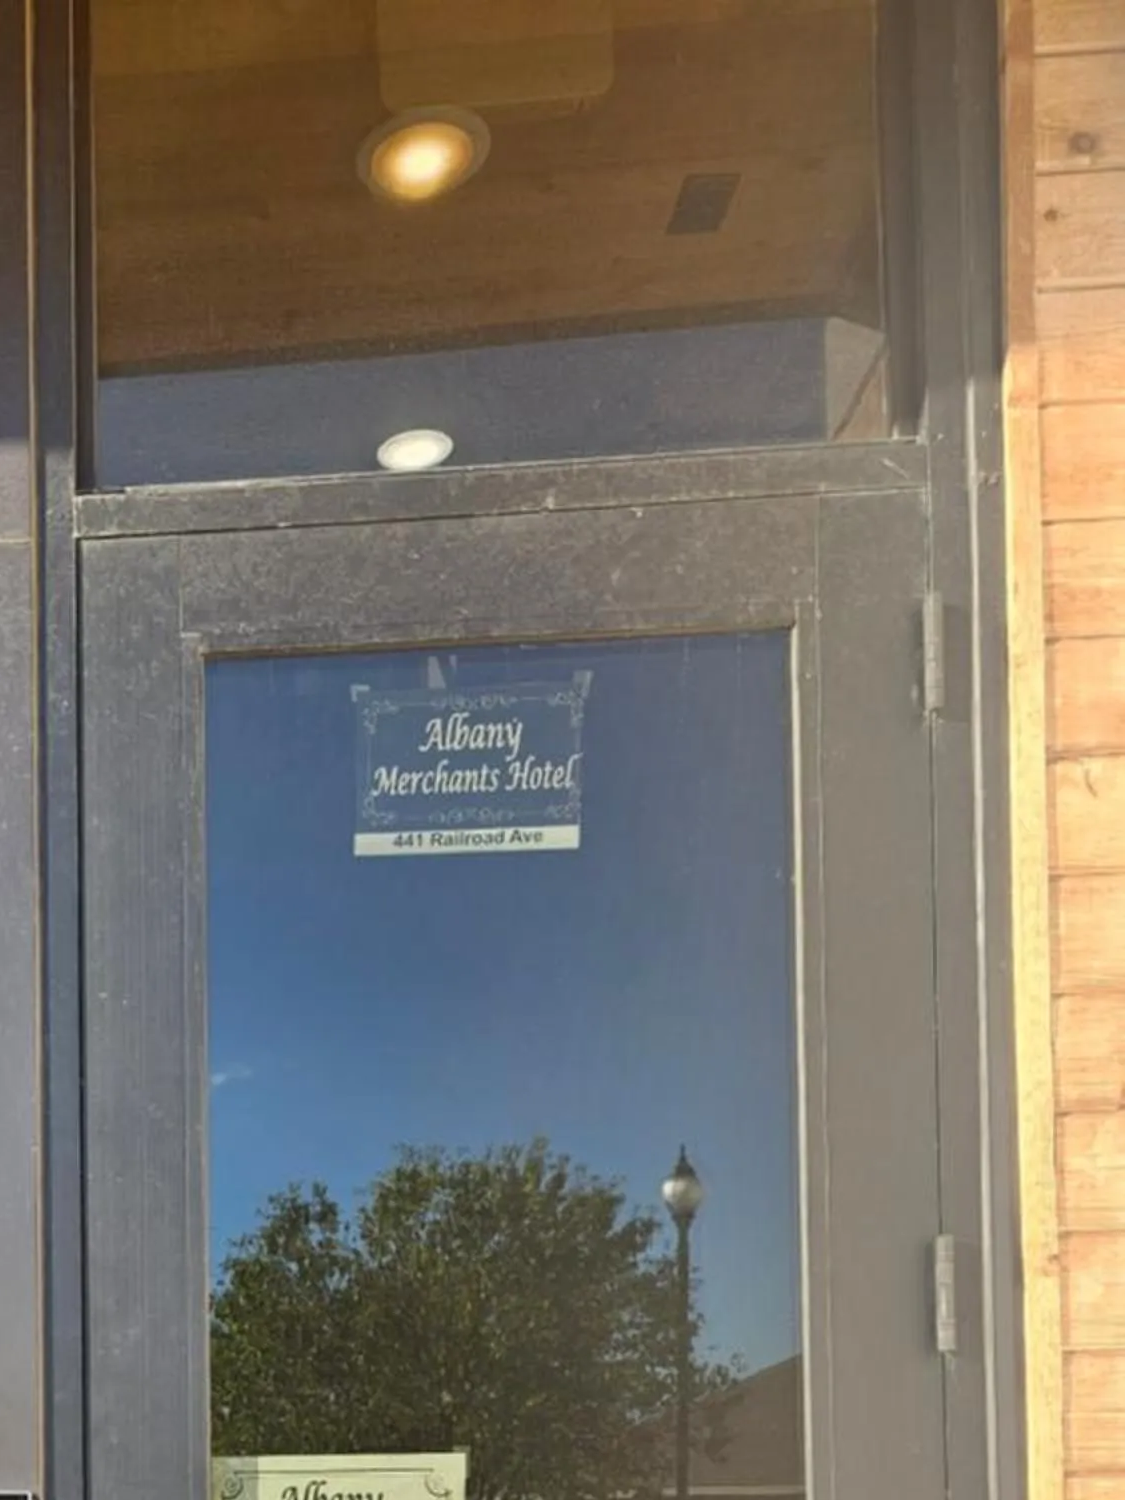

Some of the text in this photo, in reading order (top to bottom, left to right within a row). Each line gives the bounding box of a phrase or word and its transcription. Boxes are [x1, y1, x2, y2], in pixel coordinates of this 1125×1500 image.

[418, 711, 524, 761] Albany
[371, 753, 583, 797] Merchants Hotel
[393, 828, 543, 847] 441 Railroad Ave
